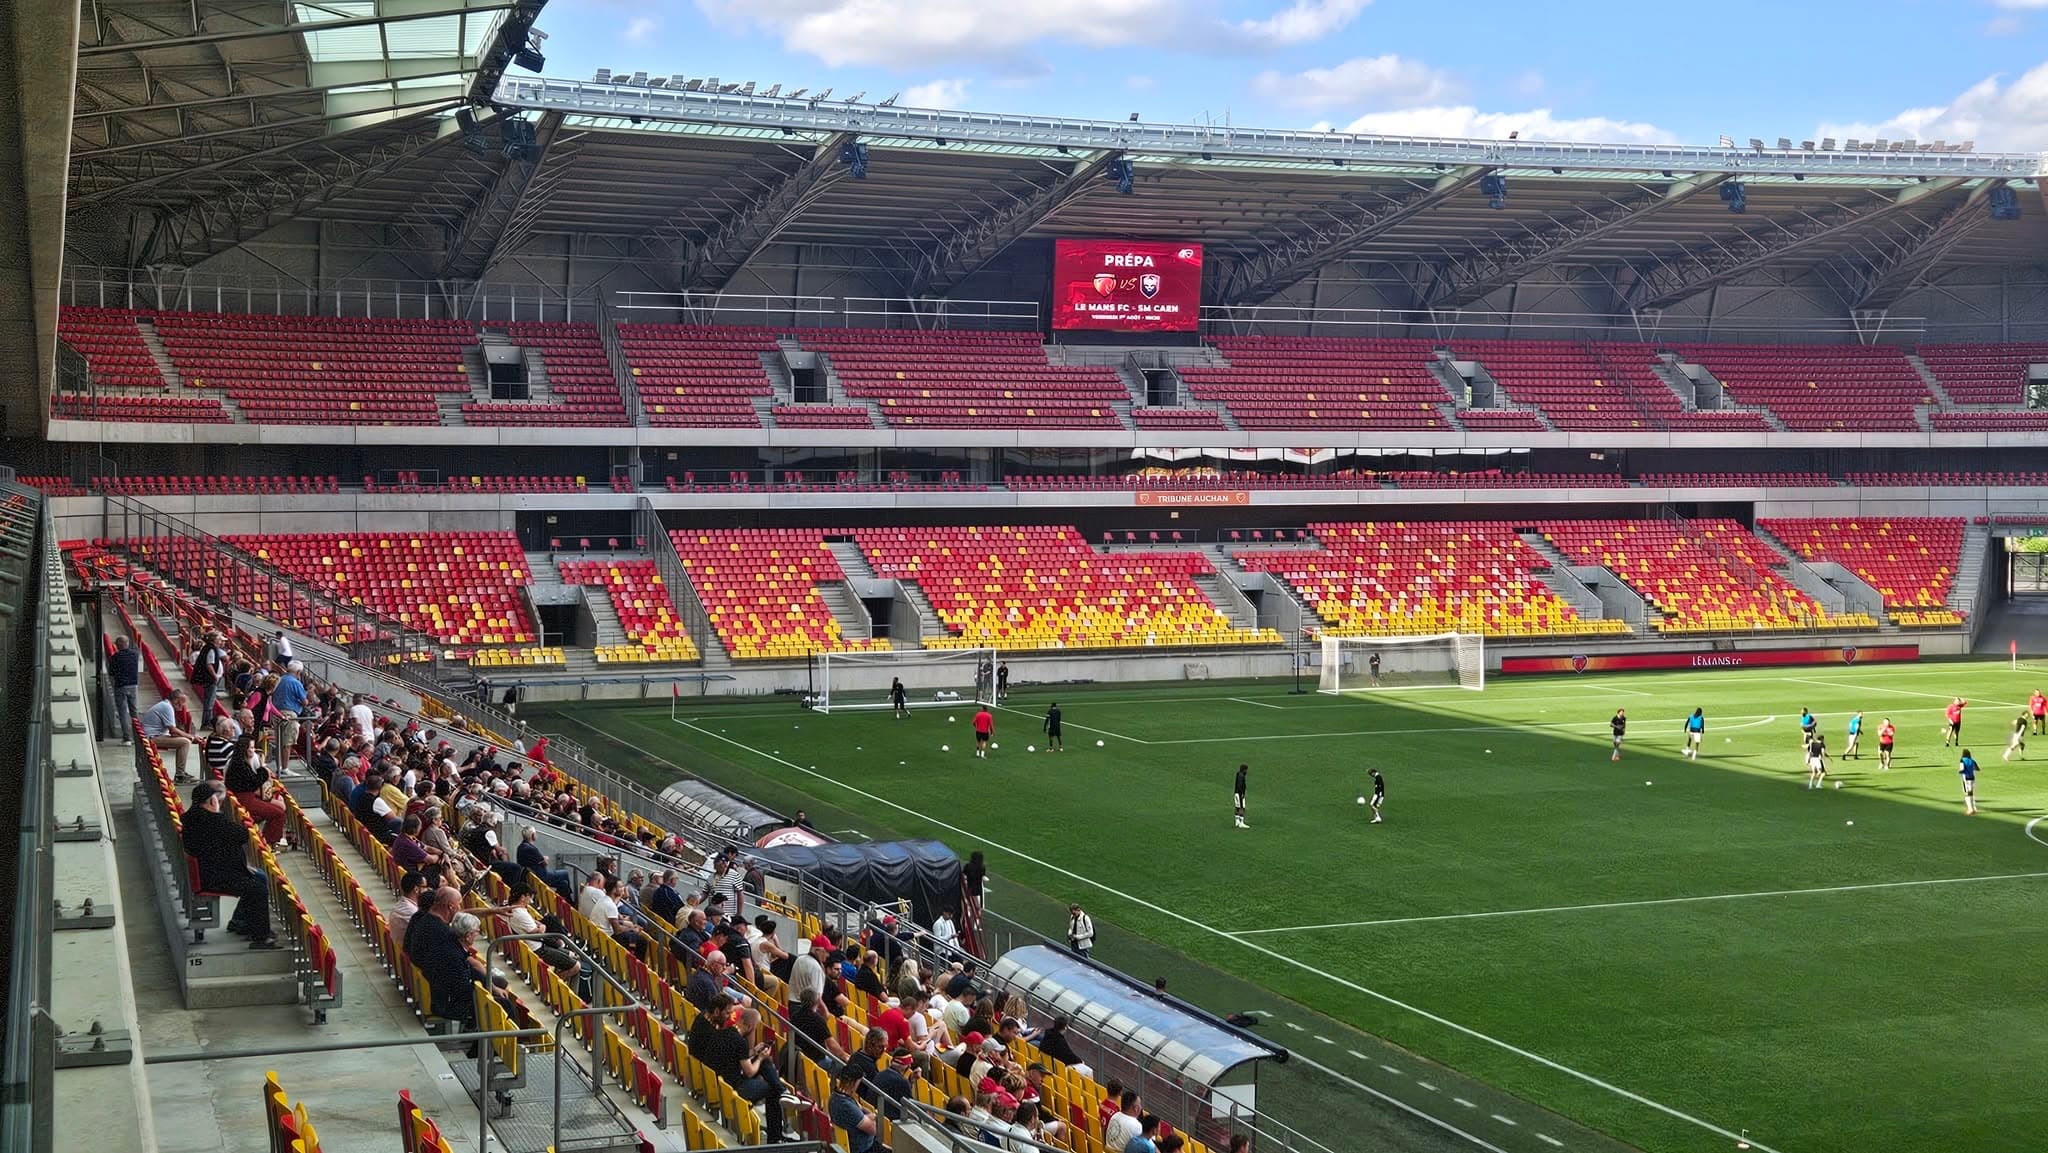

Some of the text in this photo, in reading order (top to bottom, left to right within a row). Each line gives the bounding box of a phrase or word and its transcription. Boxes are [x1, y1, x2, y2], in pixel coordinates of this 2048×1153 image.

[1104, 252, 1154, 267] PRÉPA
[1074, 303, 1086, 311] LE
[1088, 303, 1115, 312] MANS
[1117, 304, 1130, 312] FC
[1138, 304, 1152, 312] SM
[1157, 495, 1229, 503] TRIBUNE AUCHAN
[189, 958, 203, 966] 15
